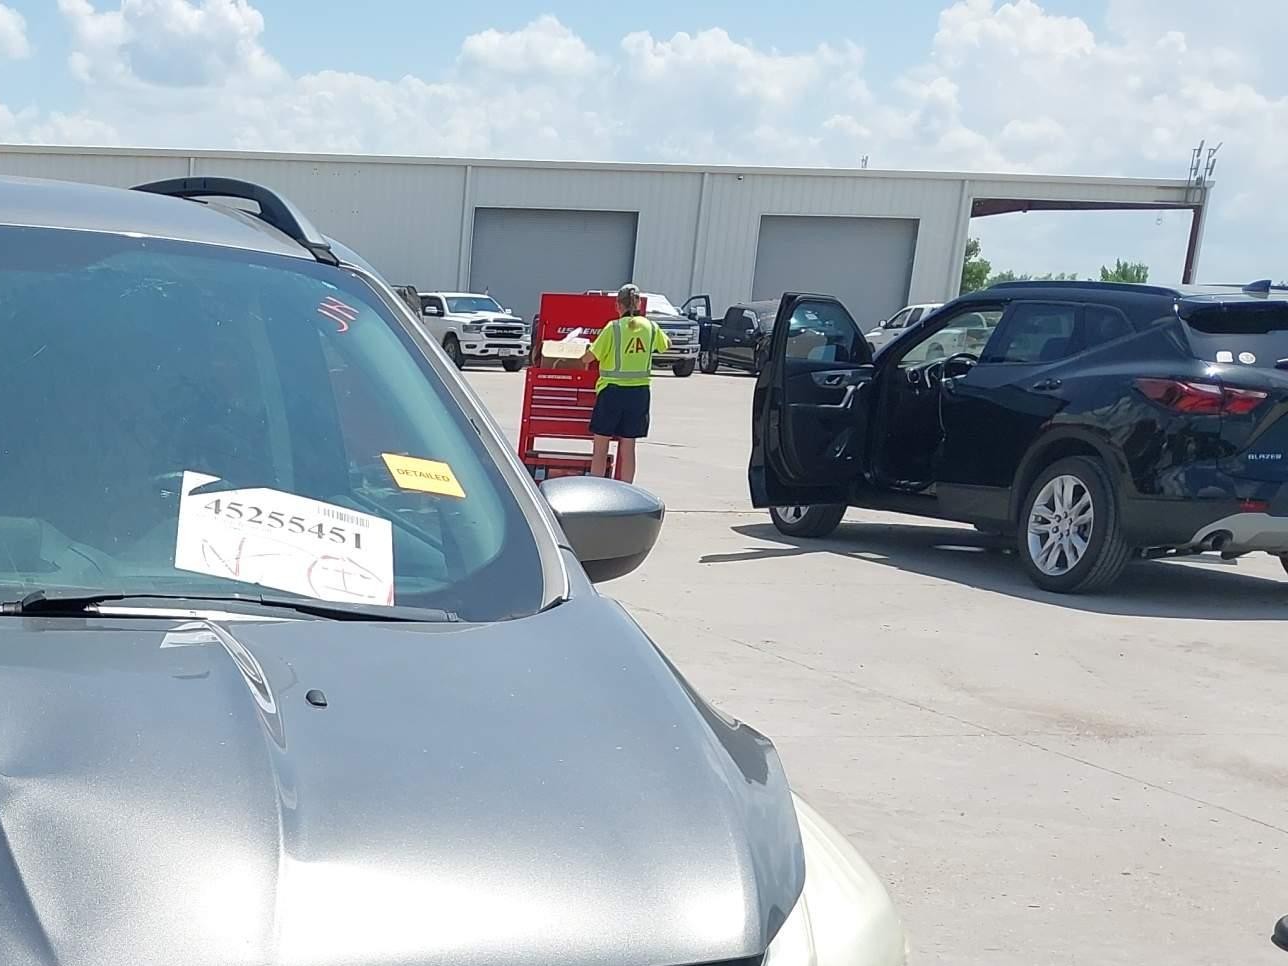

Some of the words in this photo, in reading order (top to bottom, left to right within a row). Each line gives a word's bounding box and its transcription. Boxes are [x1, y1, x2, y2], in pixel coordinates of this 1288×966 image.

[1247, 453, 1282, 461] BLAZER
[395, 467, 451, 483] DETAILED
[203, 498, 362, 549] 45255451
